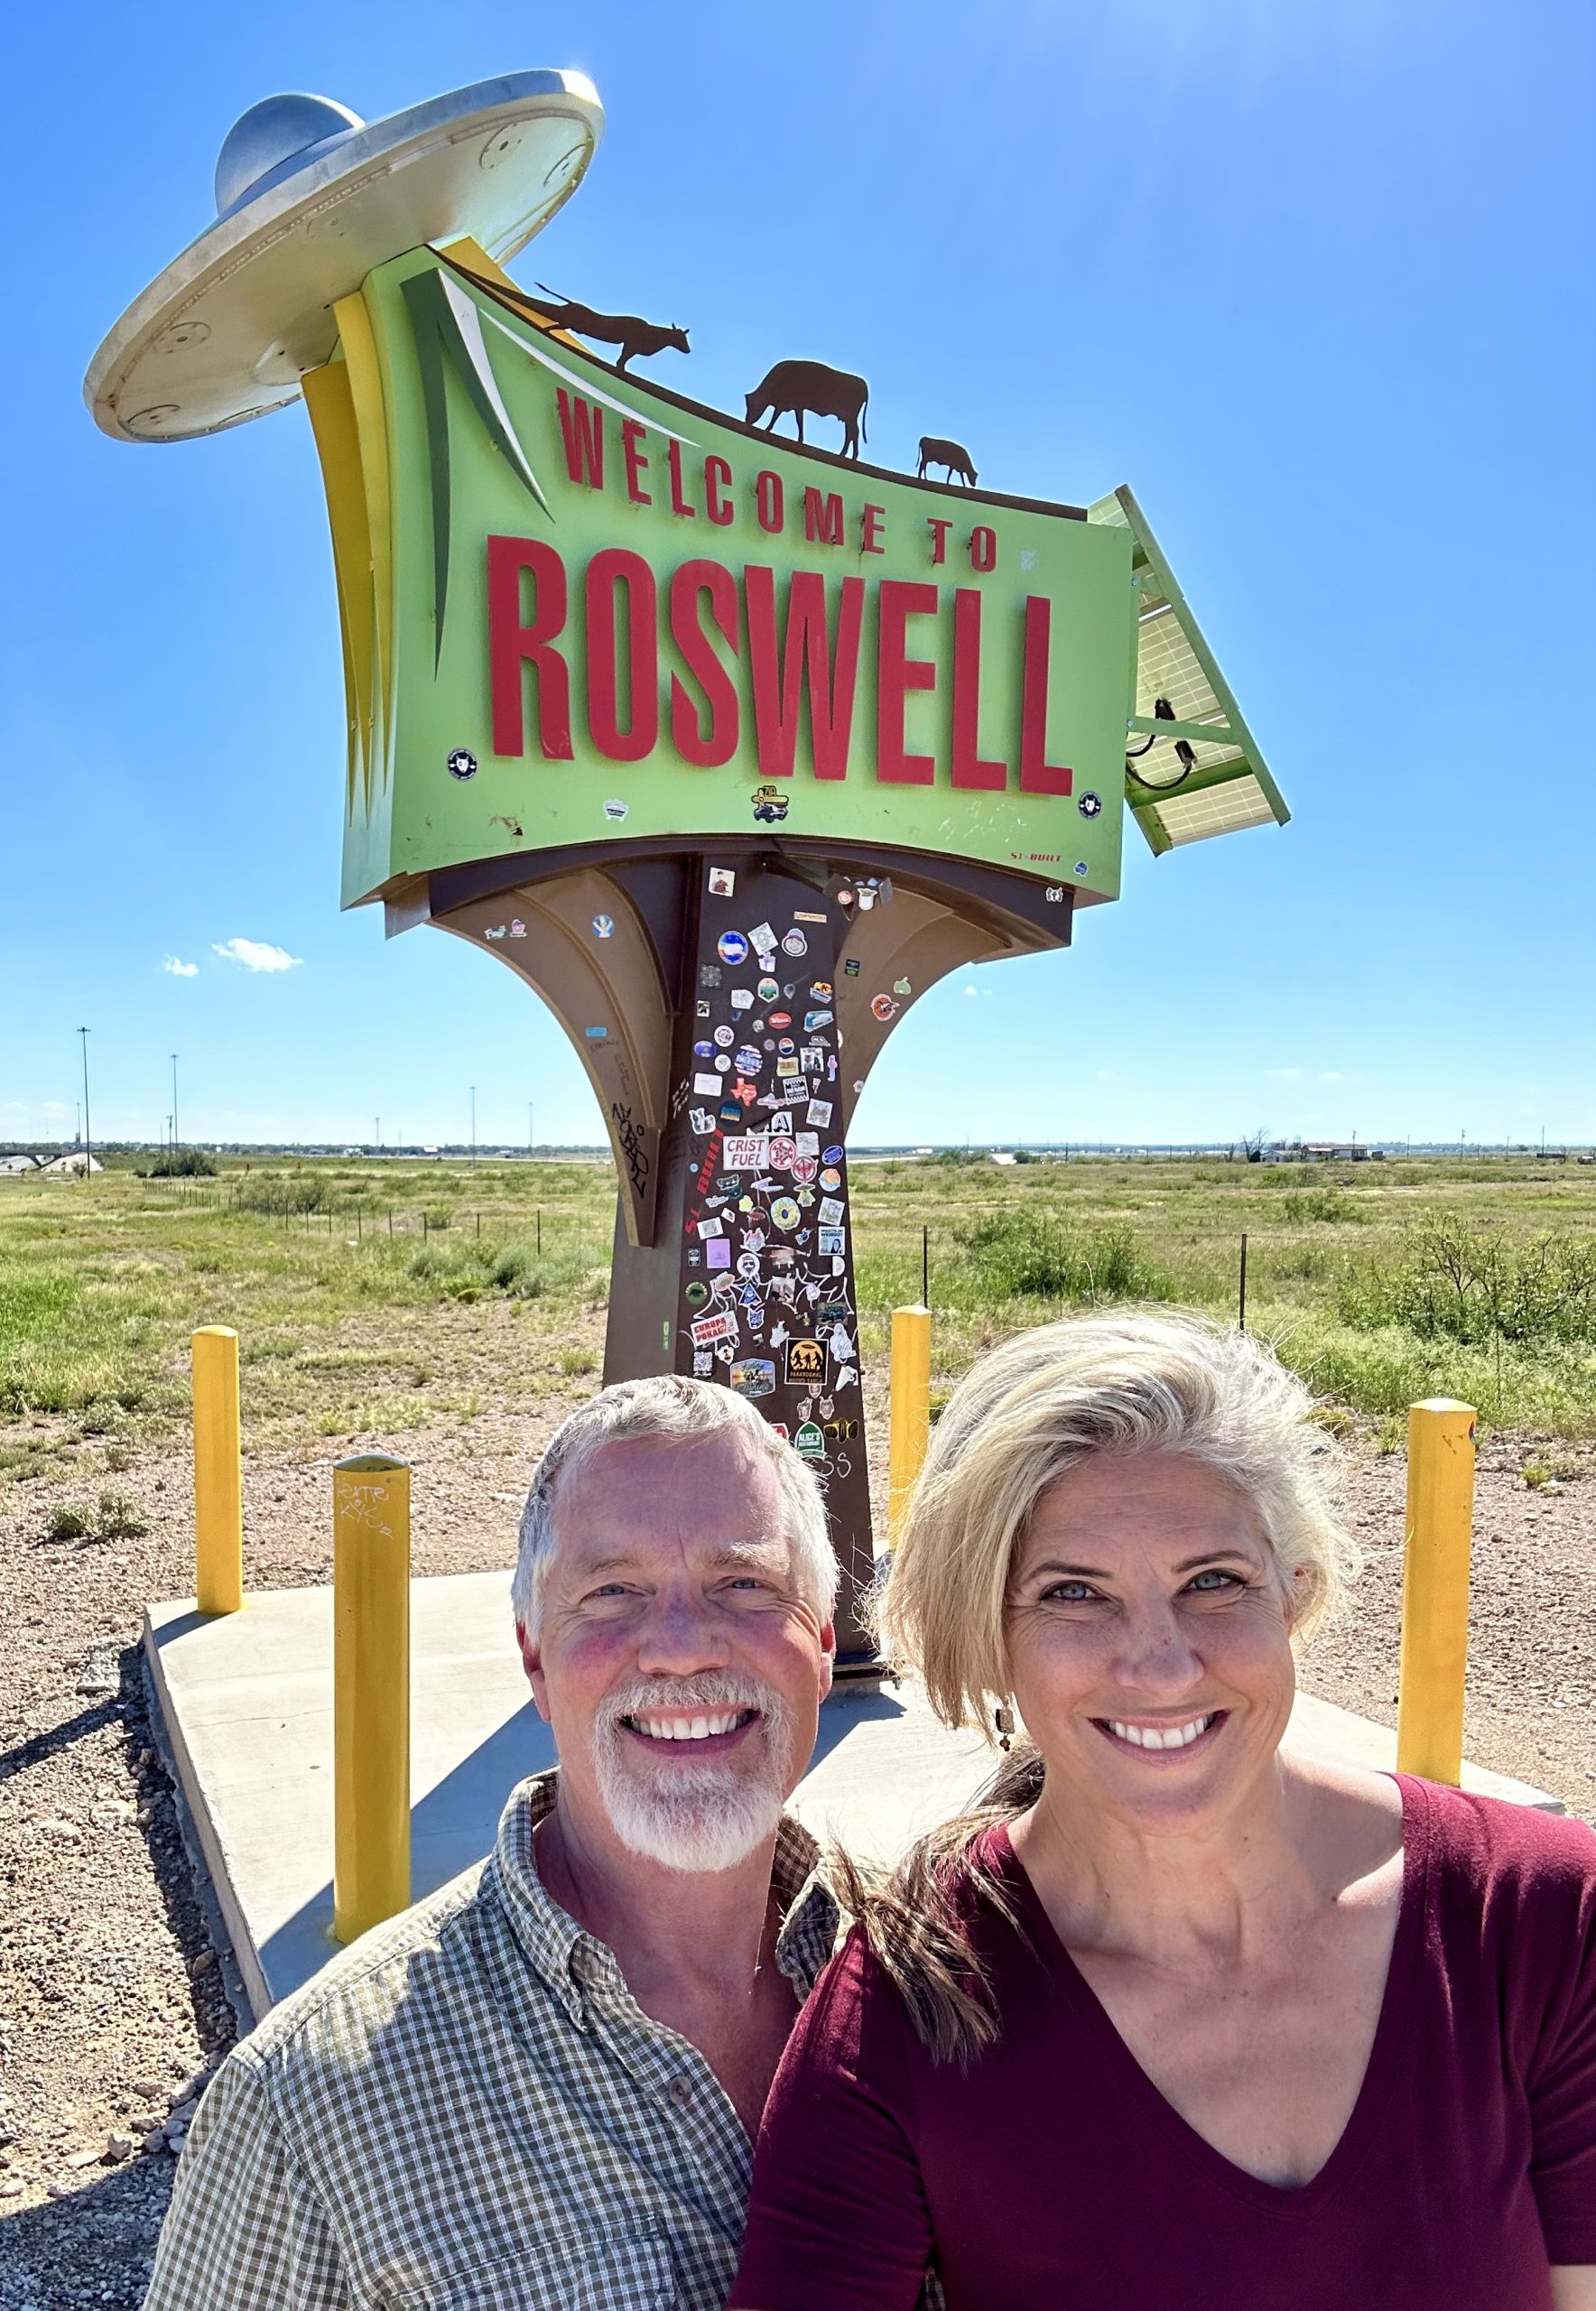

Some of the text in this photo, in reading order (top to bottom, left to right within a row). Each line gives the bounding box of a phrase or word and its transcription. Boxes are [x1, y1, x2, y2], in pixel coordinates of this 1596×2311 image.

[556, 388, 997, 572] WELCOME TO
[487, 534, 1072, 796] ROSWELL
[727, 1139, 765, 1153] CRIST
[731, 1154, 762, 1166] FUEL
[693, 1317, 727, 1333] EUROPA
[798, 1433, 821, 1442] ALICE'S
